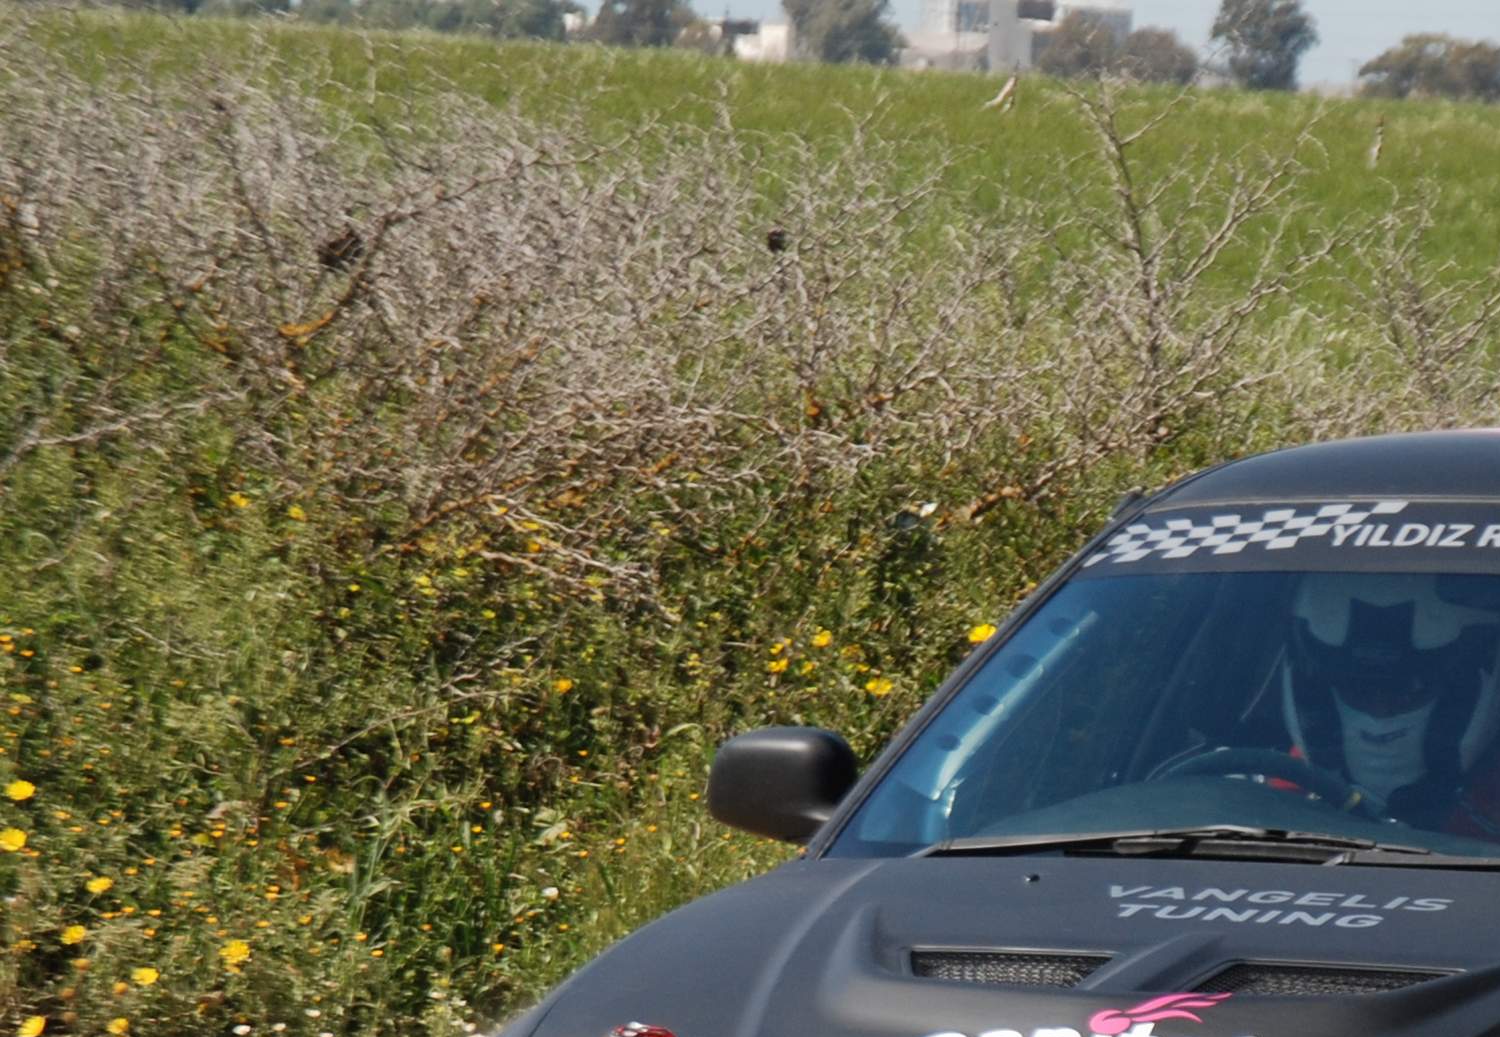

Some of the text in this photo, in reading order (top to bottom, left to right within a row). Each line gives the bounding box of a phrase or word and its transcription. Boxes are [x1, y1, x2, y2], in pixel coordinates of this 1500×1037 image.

[1332, 523, 1474, 548] YILDIZ
[1107, 884, 1455, 912] VANGELIS
[1117, 903, 1384, 929] TUNING
